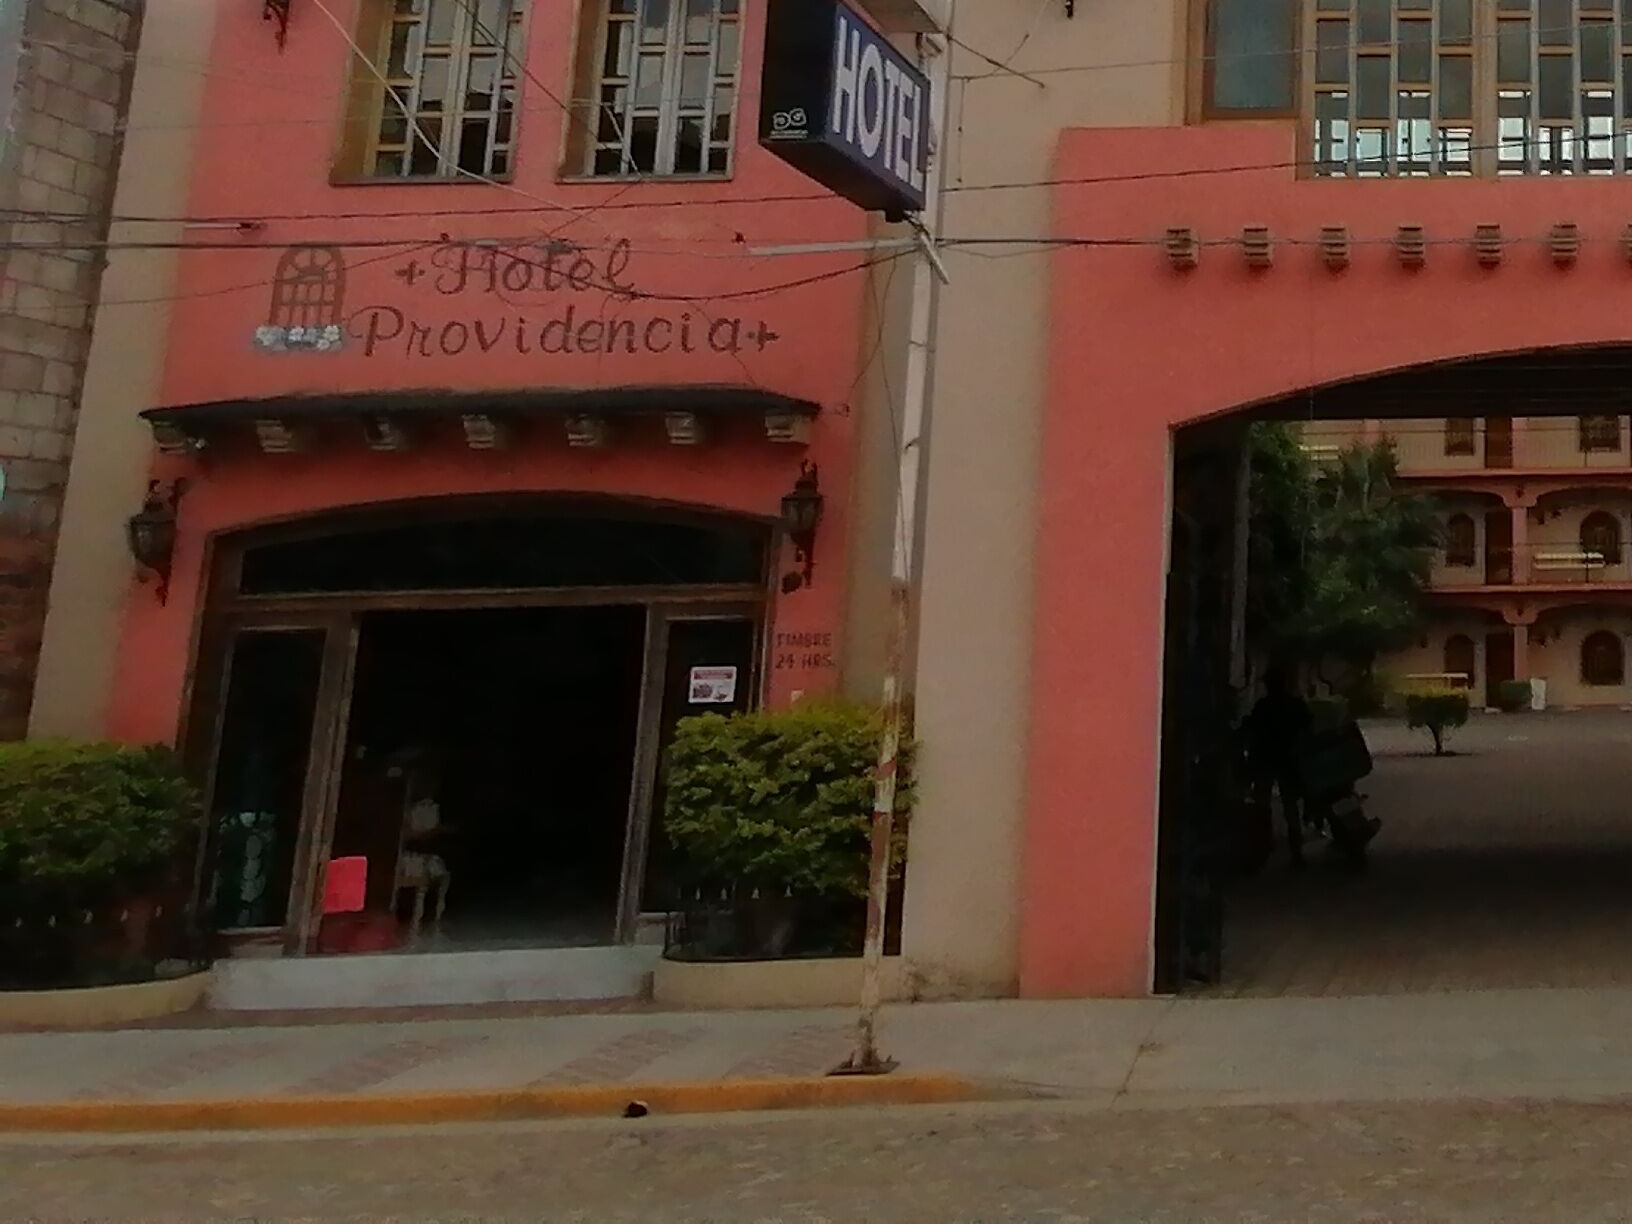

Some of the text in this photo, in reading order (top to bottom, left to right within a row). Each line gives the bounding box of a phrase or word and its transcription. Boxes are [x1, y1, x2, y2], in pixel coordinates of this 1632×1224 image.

[832, 15, 922, 192] HOTEL
[430, 239, 634, 295] Hotel
[347, 304, 743, 358] Providencia
